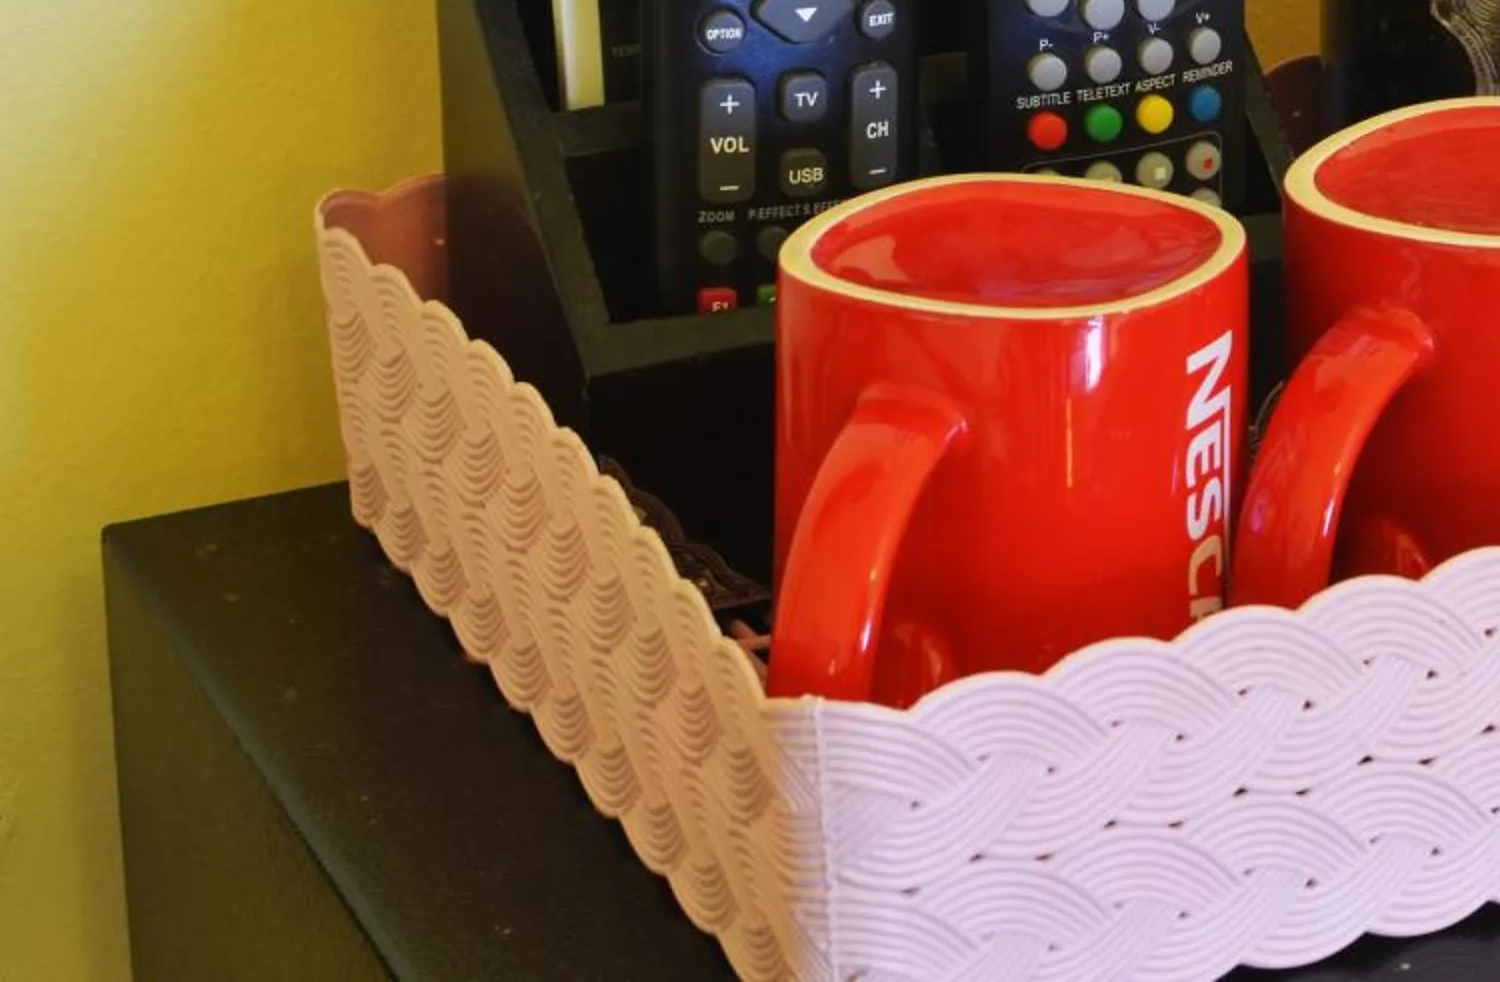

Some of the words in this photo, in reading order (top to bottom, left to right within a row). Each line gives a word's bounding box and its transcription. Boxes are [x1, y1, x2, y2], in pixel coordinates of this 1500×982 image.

[869, 12, 894, 27] EXIT
[705, 27, 743, 41] OPTION
[1039, 38, 1053, 51] P-
[1093, 31, 1111, 43] P+
[1148, 23, 1161, 35] V-
[1195, 12, 1211, 24] V+
[1016, 91, 1071, 110] SUBTITLE
[1076, 82, 1131, 102] TELETEXT
[1135, 74, 1176, 93] ASPECT
[1182, 60, 1233, 83] REMINDER
[795, 92, 819, 107] TV
[866, 121, 889, 139] CH
[710, 136, 749, 154] VOL
[789, 168, 824, 184] USB
[698, 209, 735, 223] ZOOM
